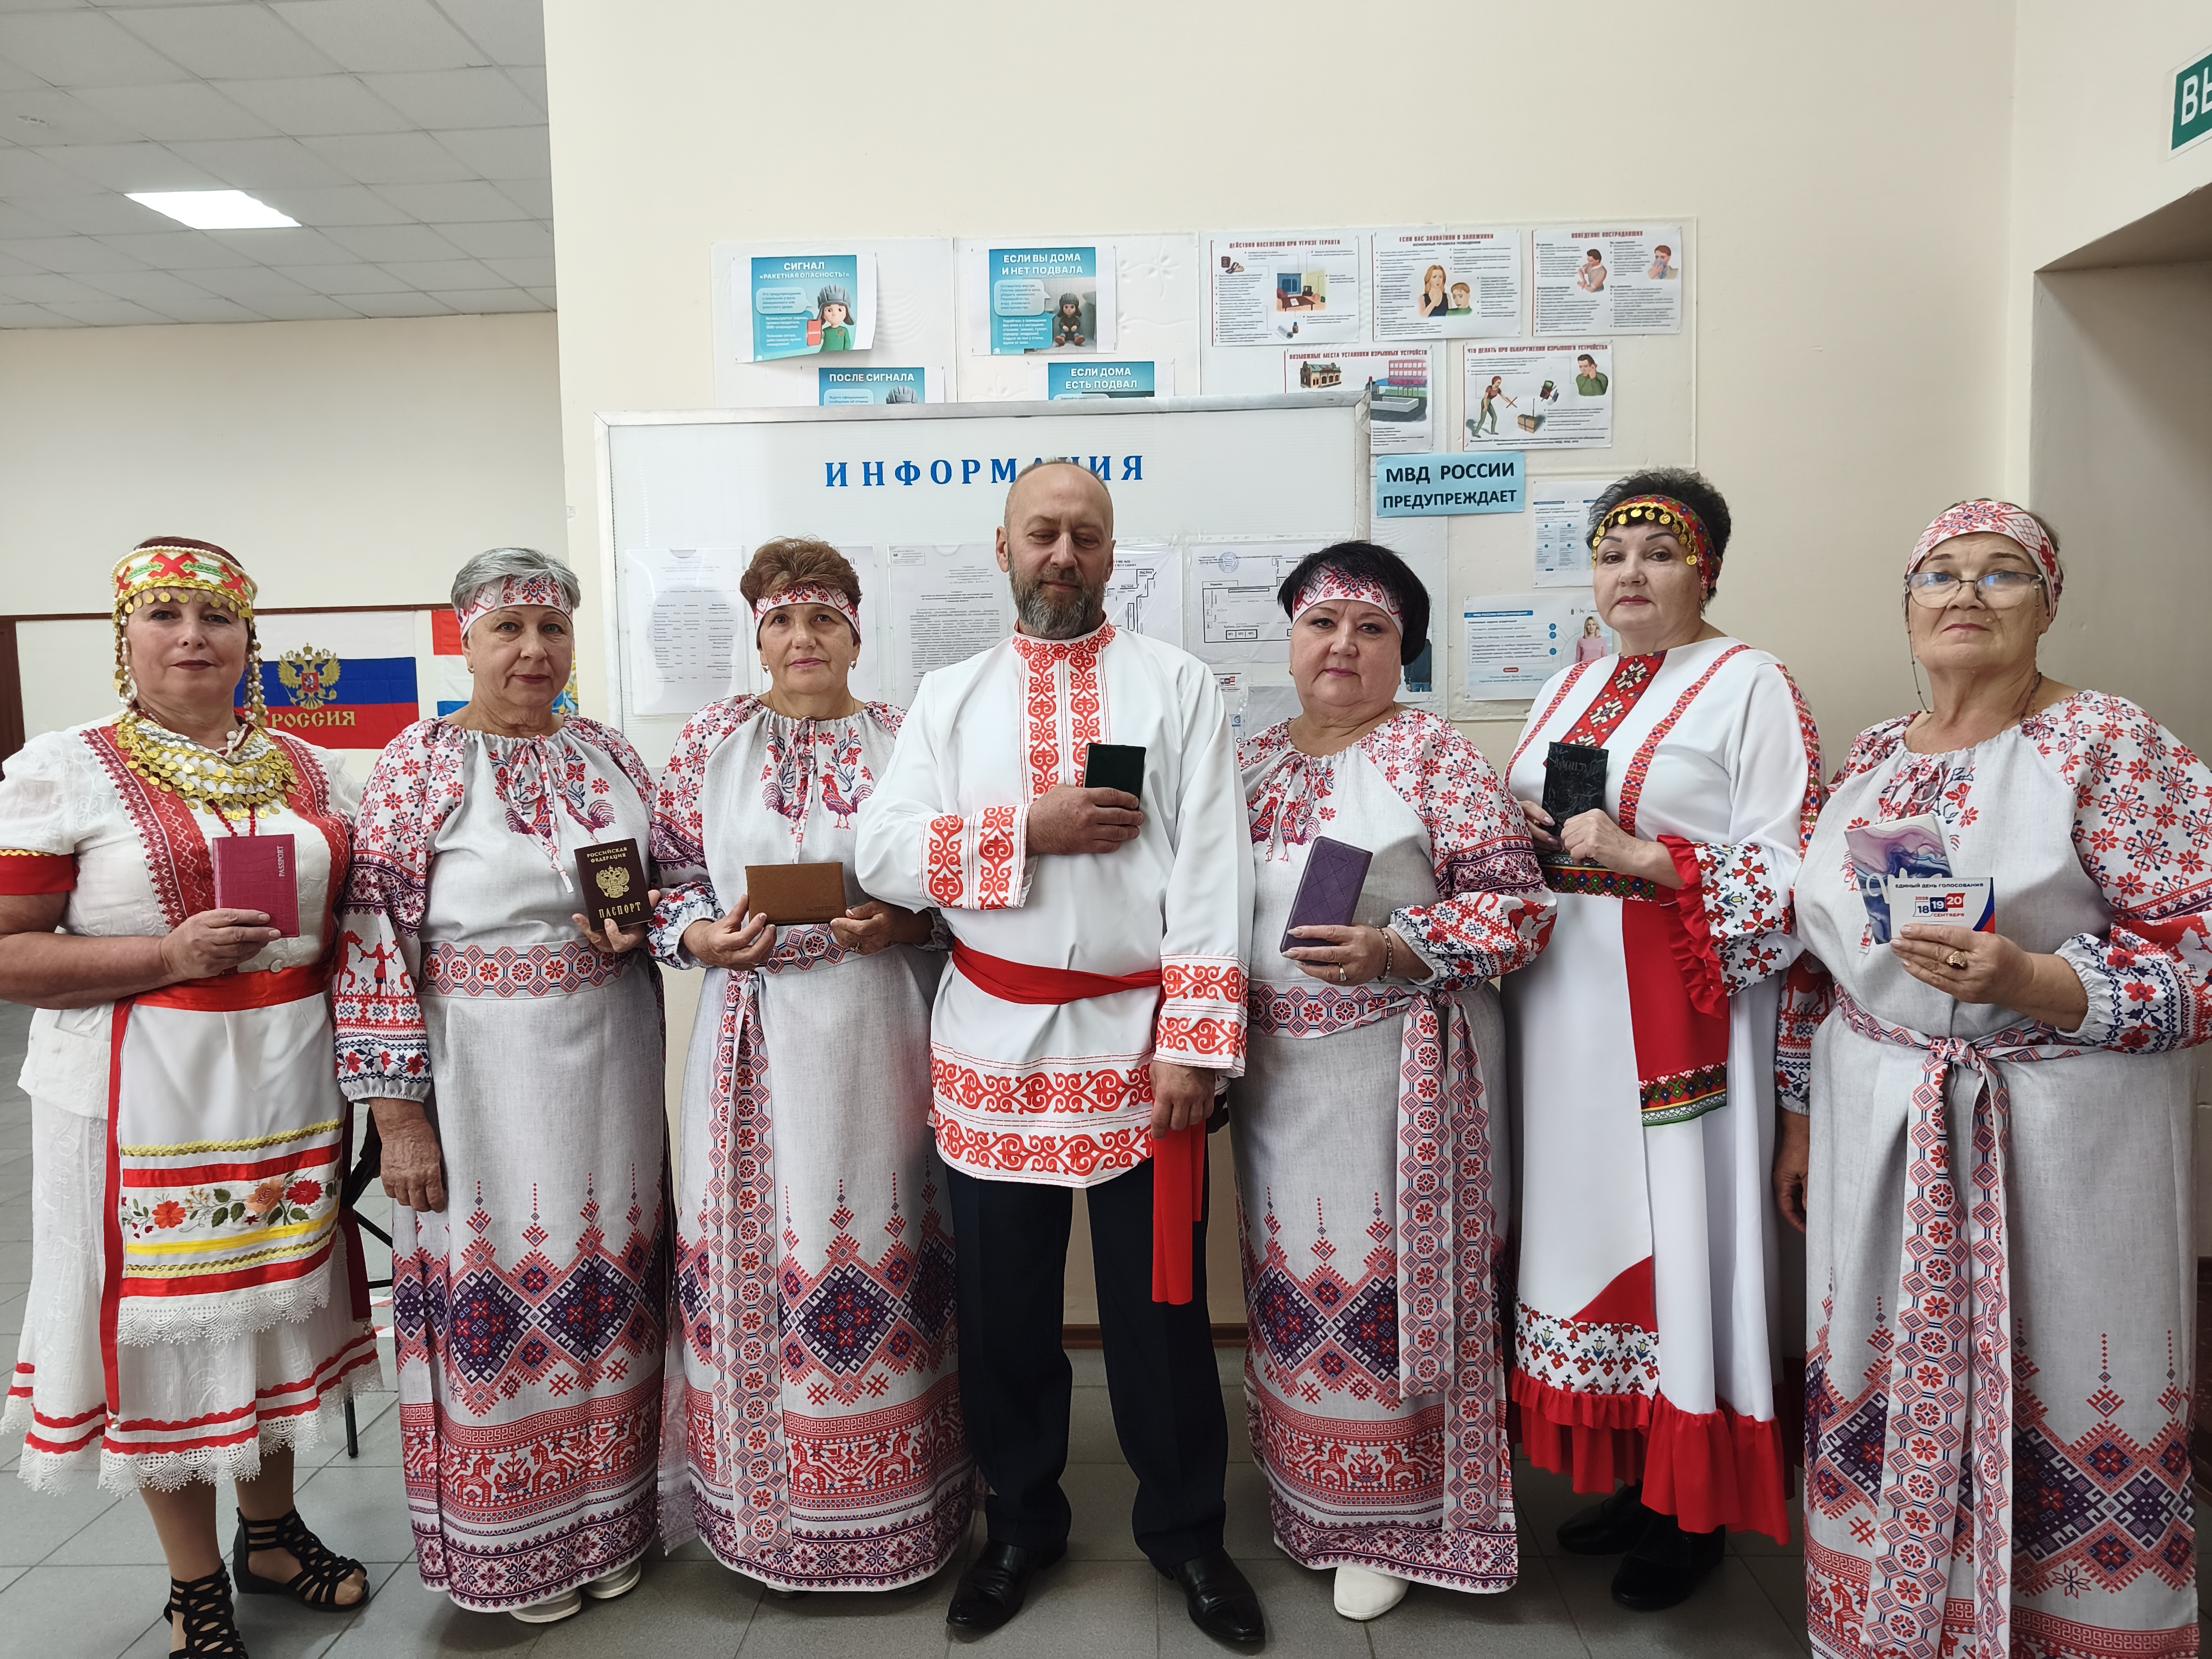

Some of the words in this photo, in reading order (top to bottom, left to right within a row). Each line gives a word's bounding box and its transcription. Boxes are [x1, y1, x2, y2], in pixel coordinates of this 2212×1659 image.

[1004, 254, 1031, 263] ЕСЛИ
[1032, 254, 1047, 262] ВЫ
[1049, 254, 1081, 263] ДОМА
[783, 261, 825, 271] СИГНАЛ
[1002, 267, 1009, 275] И
[1011, 267, 1031, 275] НЕТ
[1032, 266, 1083, 276] ПОДВАЛА
[829, 374, 864, 382] ПОСЛЕ
[866, 373, 915, 382] СИГНАЛА
[1071, 369, 1098, 377] ЕСЛИ
[1099, 368, 1131, 378] ДОМА
[1065, 381, 1091, 389] ЕСТЬ
[1094, 380, 1137, 390] ПОДВАЛ
[825, 455, 1143, 487] ИНФОРМИЯ
[1386, 466, 1430, 485] МВД
[1441, 462, 1514, 480] РОССИИ
[1383, 490, 1517, 510] ПРЕДУПРЕЖДАЕТ
[271, 711, 357, 729] РОССИЯ
[587, 847, 627, 858] РОССИЙСКАЯ
[276, 845, 285, 877] PASSPORT
[590, 853, 626, 863] ФЕДЕРАЦИЯ
[1931, 901, 1944, 909] 19
[1946, 896, 1962, 905] 20
[599, 902, 641, 918] ПАСПОРТ
[1917, 905, 1930, 914] 18
